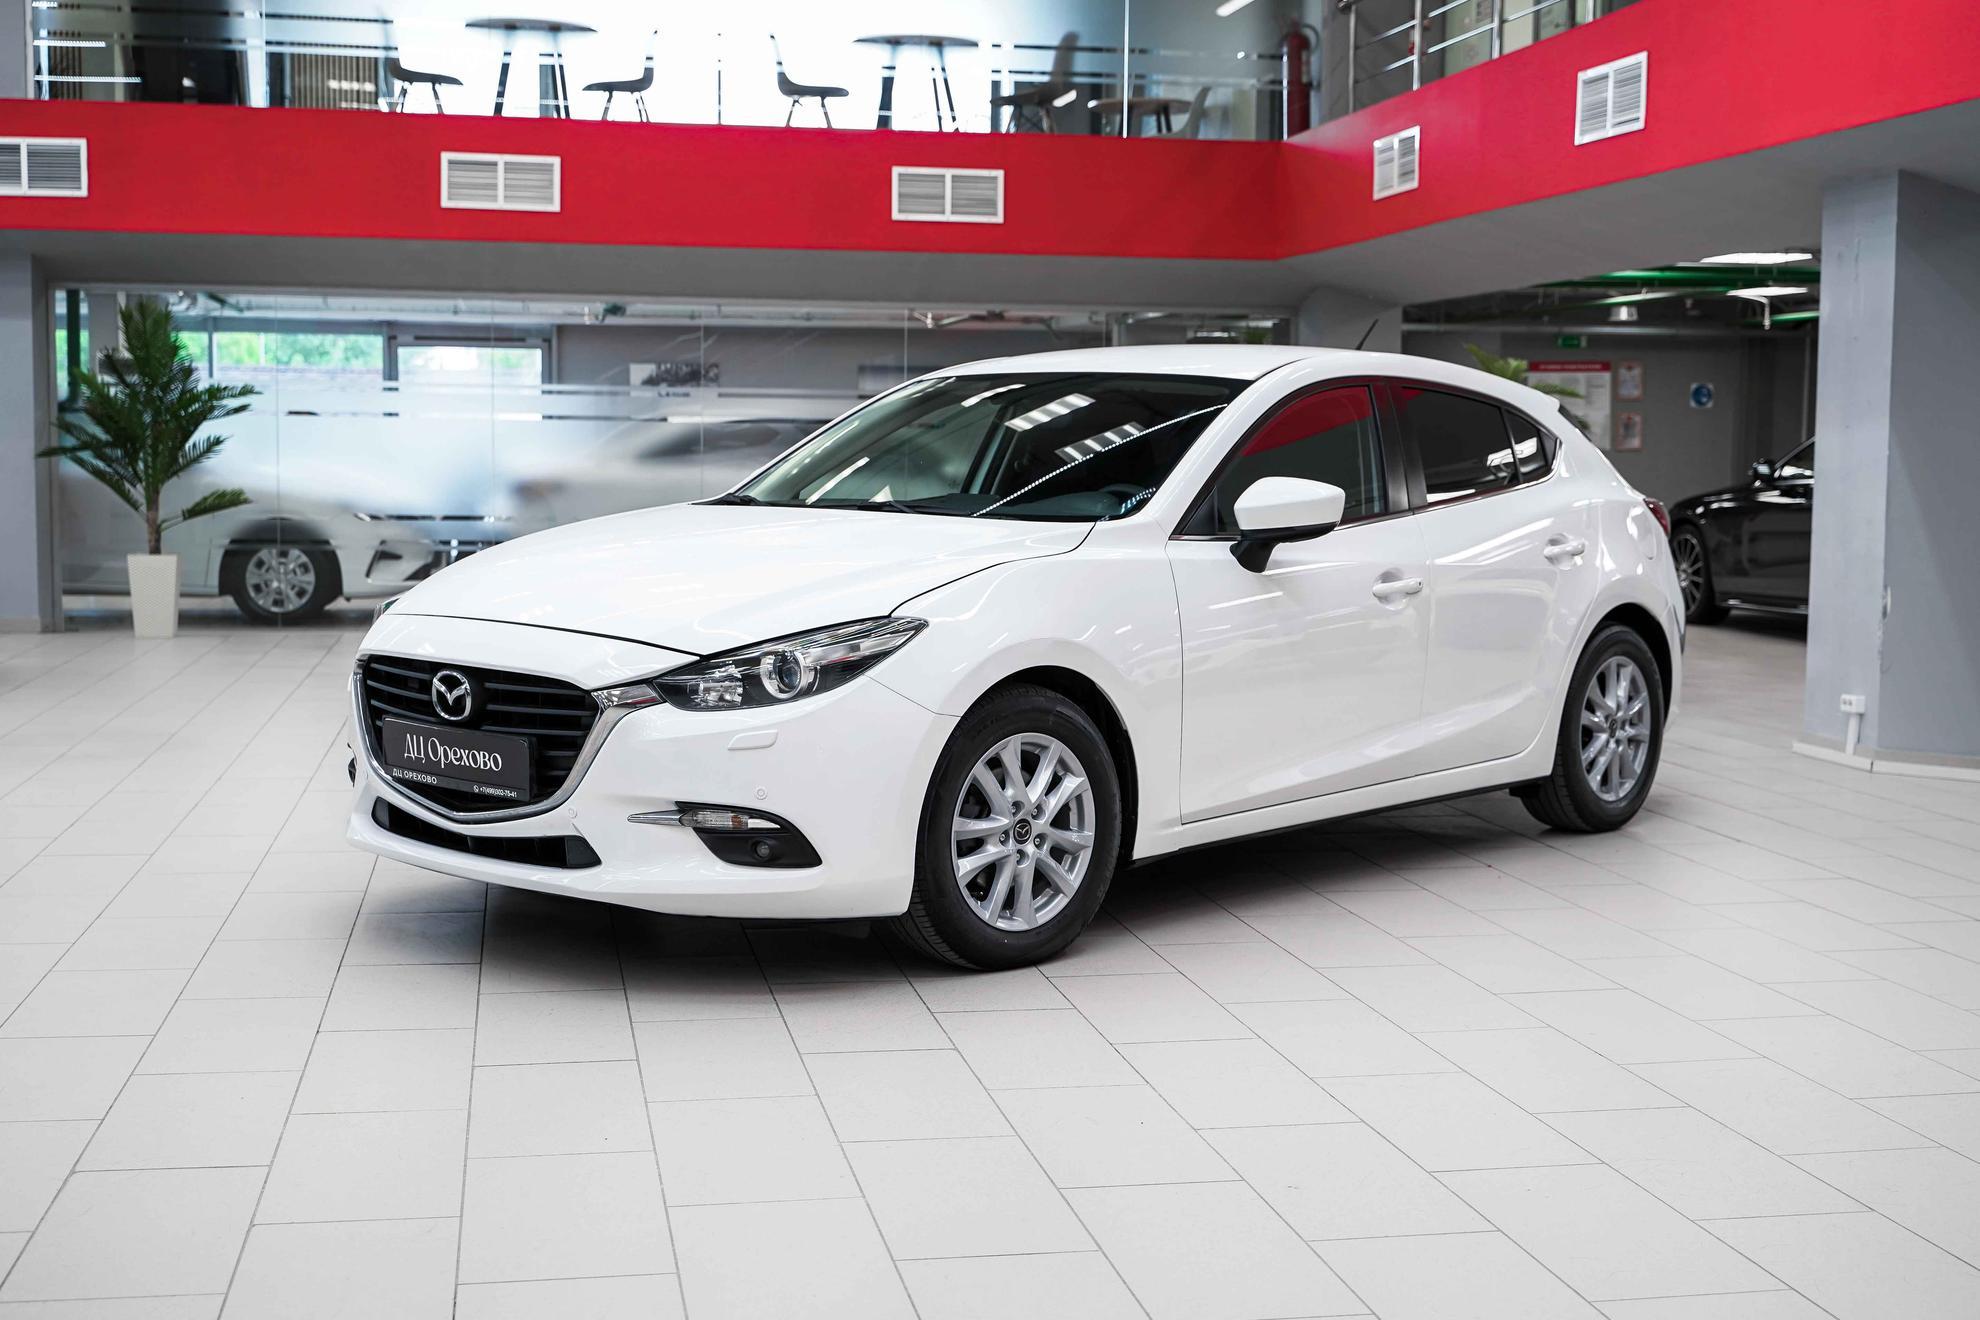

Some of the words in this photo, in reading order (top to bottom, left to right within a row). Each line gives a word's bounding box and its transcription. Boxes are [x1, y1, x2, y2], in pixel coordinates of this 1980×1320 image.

[404, 733, 425, 763] ДЦ
[428, 737, 502, 771] Орехово
[392, 768, 403, 778] ДЦ
[403, 770, 437, 784] ОРЕХОВО
